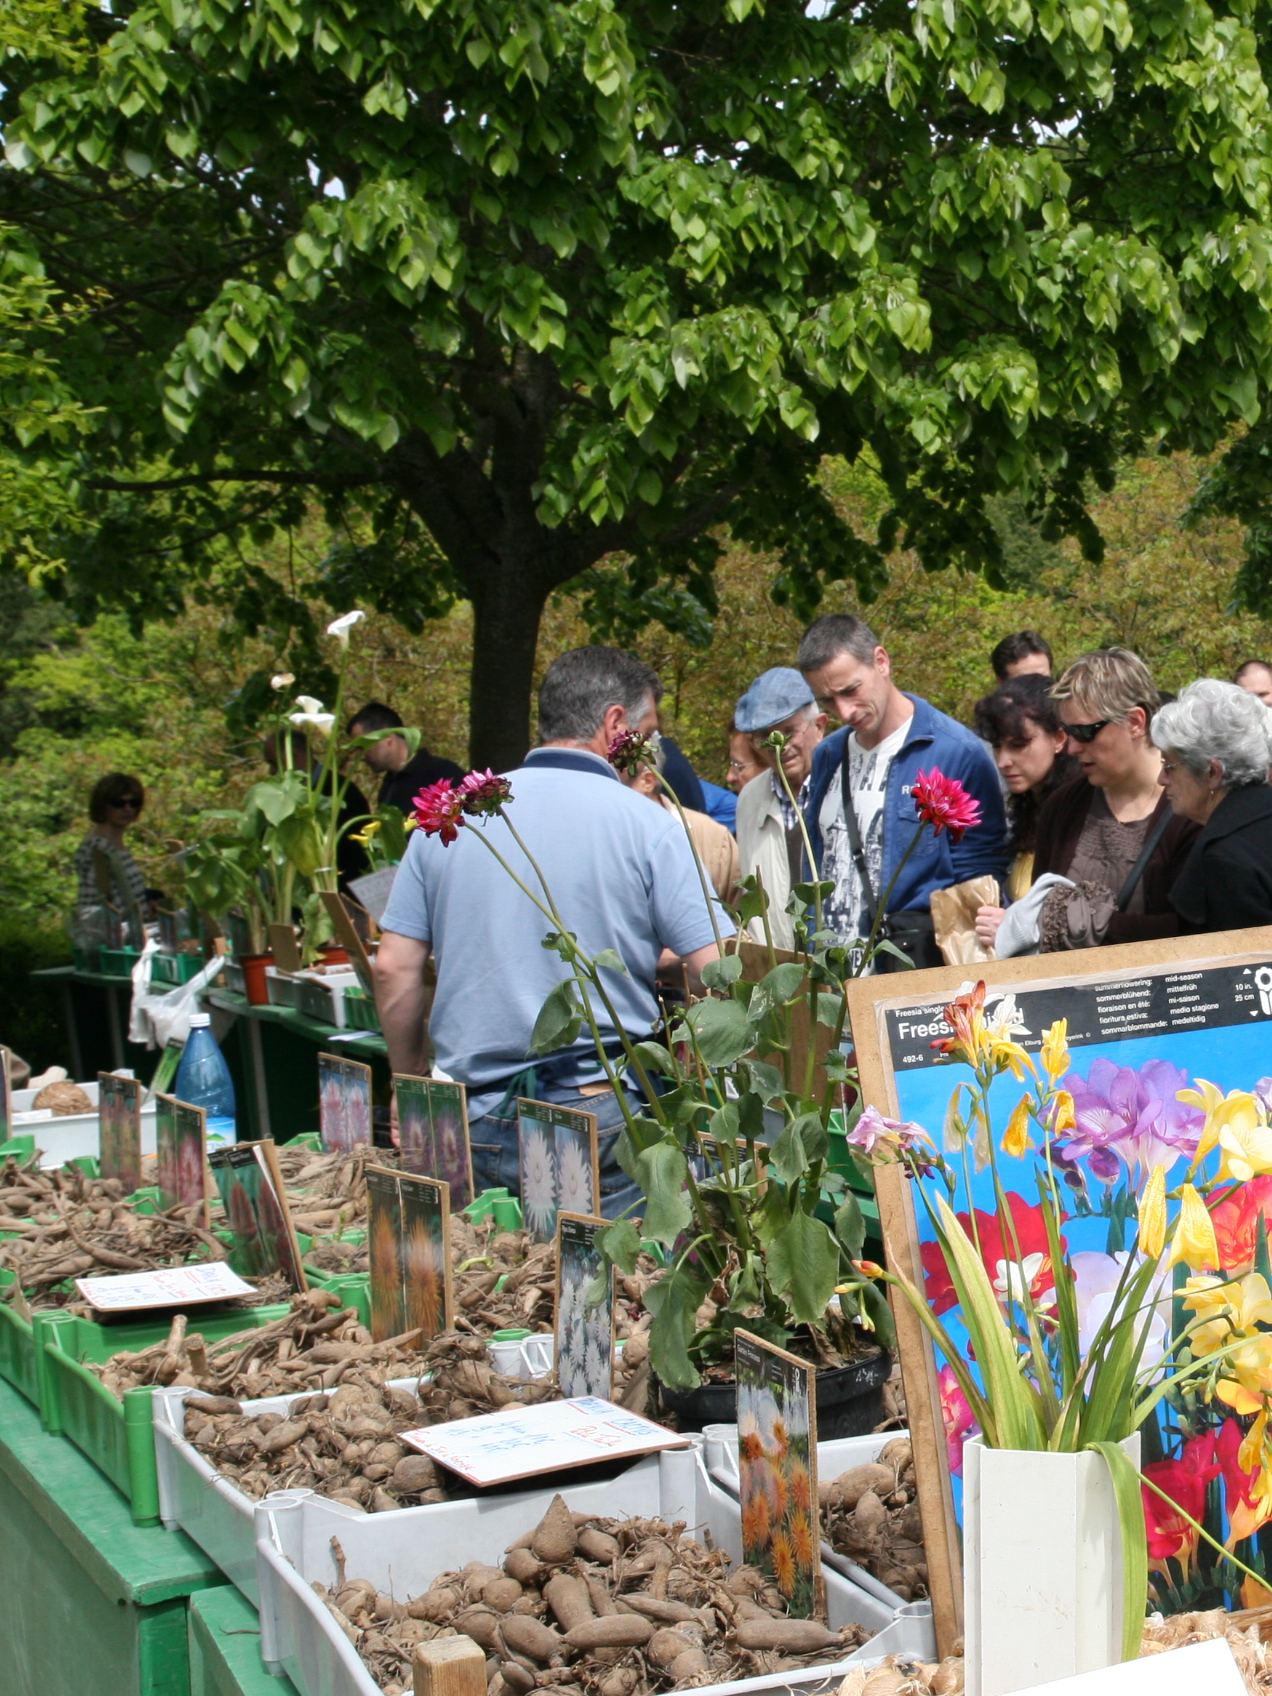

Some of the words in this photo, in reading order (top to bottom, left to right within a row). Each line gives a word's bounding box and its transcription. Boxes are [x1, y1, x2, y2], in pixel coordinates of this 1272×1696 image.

[1165, 972, 1203, 982] mid-season
[1166, 983, 1198, 994] mittelfrüh
[1244, 982, 1253, 990] in.
[1127, 1002, 1137, 1010] en
[1168, 994, 1200, 1004] mi-saison
[1234, 993, 1243, 1001] 25
[1244, 993, 1255, 1001] cm
[895, 1007, 922, 1018] Freesia
[1170, 1006, 1190, 1015] medio
[1191, 1002, 1220, 1013] stagione
[898, 1020, 955, 1040] Frees
[1101, 1019, 1168, 1035] sommarblommande:
[1171, 1015, 1206, 1026] medeltidig
[902, 1054, 924, 1064] 492-6
